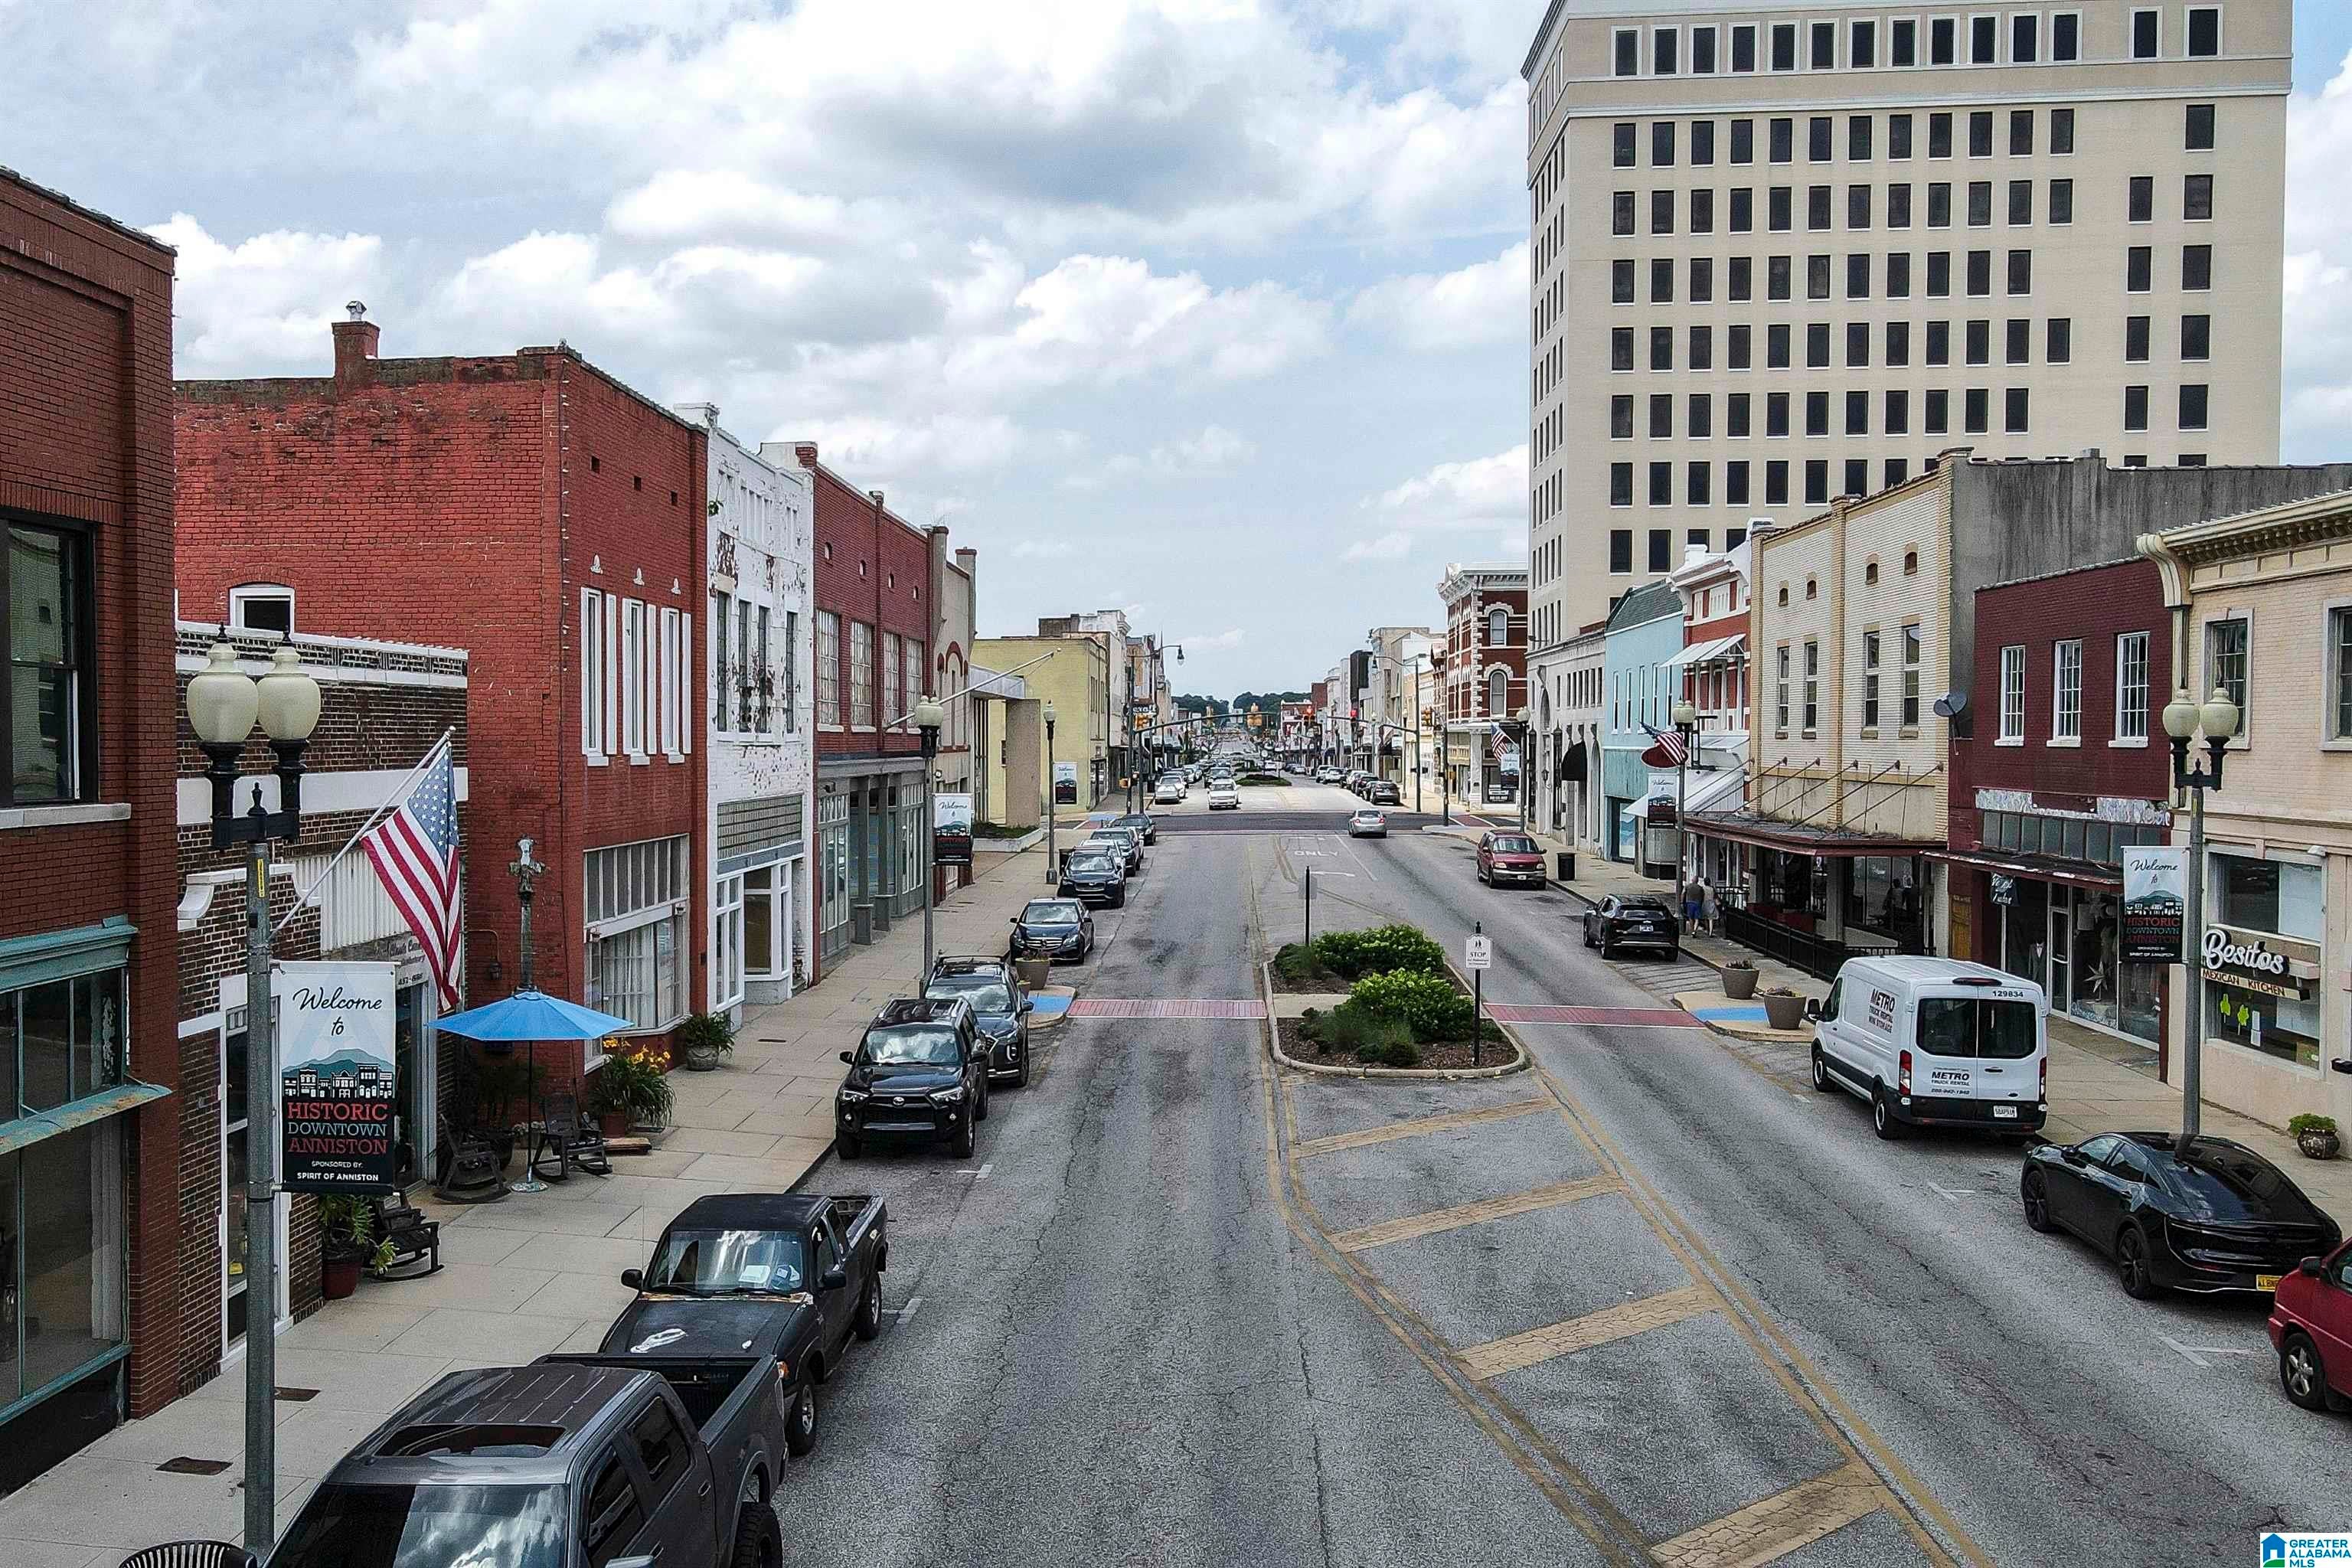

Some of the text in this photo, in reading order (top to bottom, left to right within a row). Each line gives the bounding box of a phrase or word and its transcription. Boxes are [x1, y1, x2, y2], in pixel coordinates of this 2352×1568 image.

[2130, 859, 2178, 871] Welcome
[2151, 874, 2158, 884] to
[2127, 917, 2180, 926] HISTORIC
[2203, 929, 2284, 975] Besitos
[2203, 969, 2285, 996] MEXICAN KITCHEN
[292, 987, 382, 1011] Welcome
[1870, 988, 1895, 1013] METRO
[331, 1017, 344, 1036] to
[1932, 1071, 1970, 1081] METRO
[287, 1102, 388, 1120] HISTORIC
[288, 1122, 387, 1137] DOWNTOWN
[287, 1138, 388, 1154] ANNISTON
[297, 1171, 379, 1182] SPIRIT OF ANNISTON
